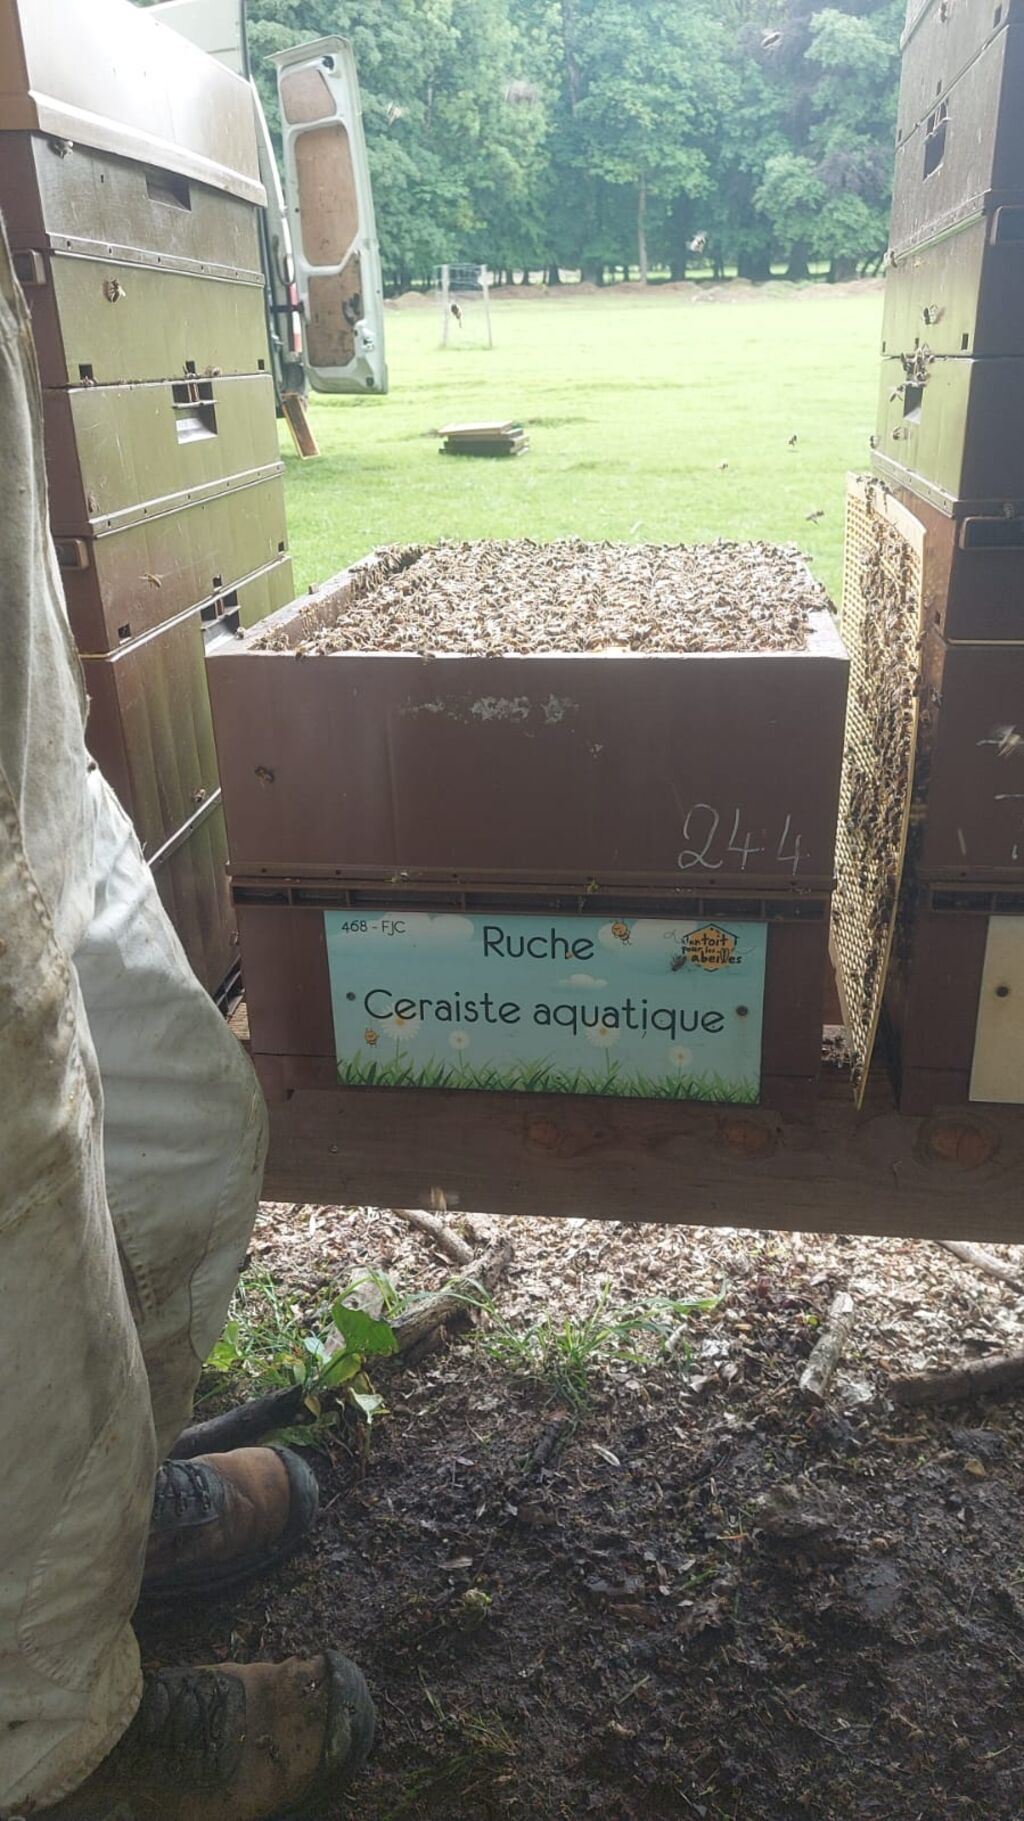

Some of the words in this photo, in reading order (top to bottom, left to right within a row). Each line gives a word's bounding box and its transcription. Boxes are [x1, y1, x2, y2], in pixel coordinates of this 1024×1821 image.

[678, 803, 803, 876] 244
[341, 920, 368, 934] 468
[381, 920, 406, 936] FJC
[483, 926, 594, 960] Ruche
[691, 948, 742, 963] abeilles
[364, 988, 520, 1025] Ceraiste
[534, 998, 725, 1039] aquatique
